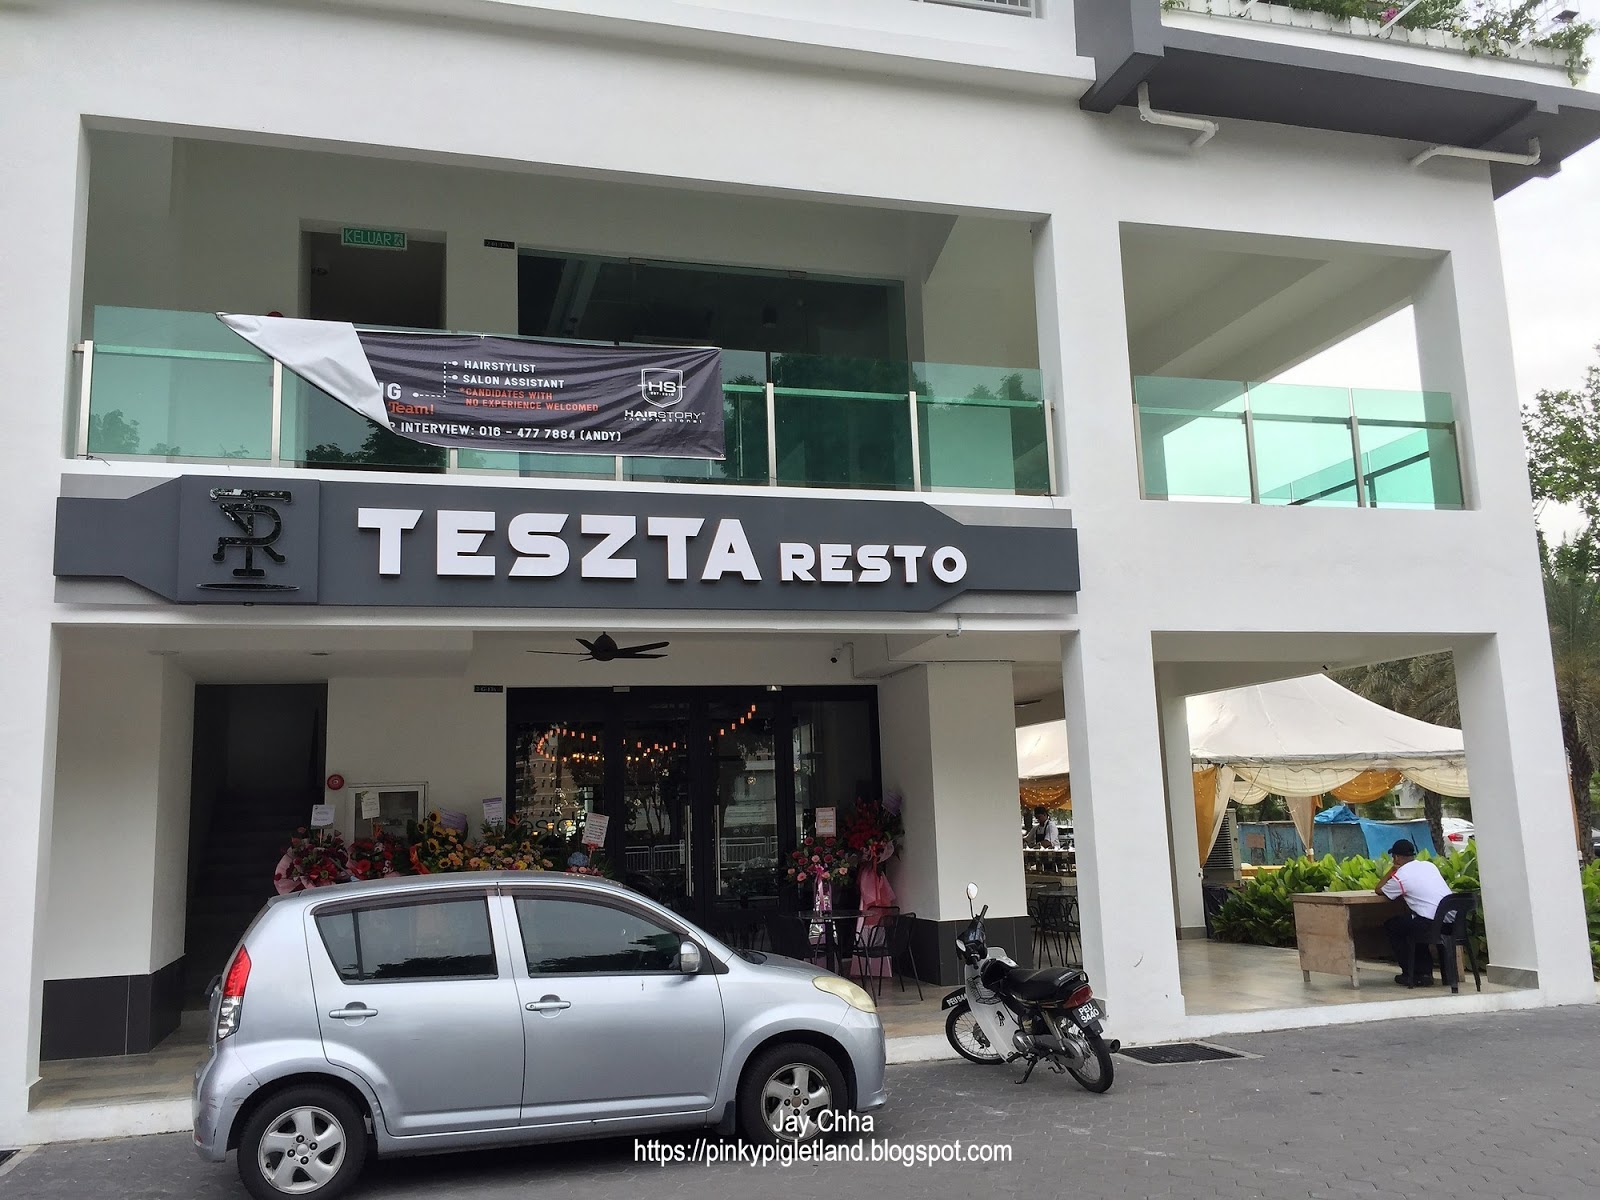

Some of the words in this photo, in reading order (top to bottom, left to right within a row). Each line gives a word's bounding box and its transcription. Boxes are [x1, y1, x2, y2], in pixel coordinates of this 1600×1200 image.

[345, 229, 392, 246] KELUAR
[464, 360, 536, 373] HAIRSTYLIST
[463, 374, 500, 386] SALON
[504, 377, 565, 388] ASSISTANT
[648, 381, 677, 393] HS
[528, 391, 553, 400] WITH
[388, 401, 435, 415] Team!
[465, 398, 479, 407] NO
[482, 399, 542, 410] EXPERIENCE
[545, 402, 599, 412] WELCOMED
[401, 421, 475, 436] INTERVIEW:
[479, 425, 501, 437] 016
[517, 428, 539, 439] 477
[544, 429, 576, 440] 7884
[580, 430, 622, 442] (ANDY)
[358, 507, 763, 582] TESZTA
[780, 543, 968, 584] RESTO
[1078, 1003, 1093, 1016] PEU
[1081, 1009, 1100, 1023] 9440
